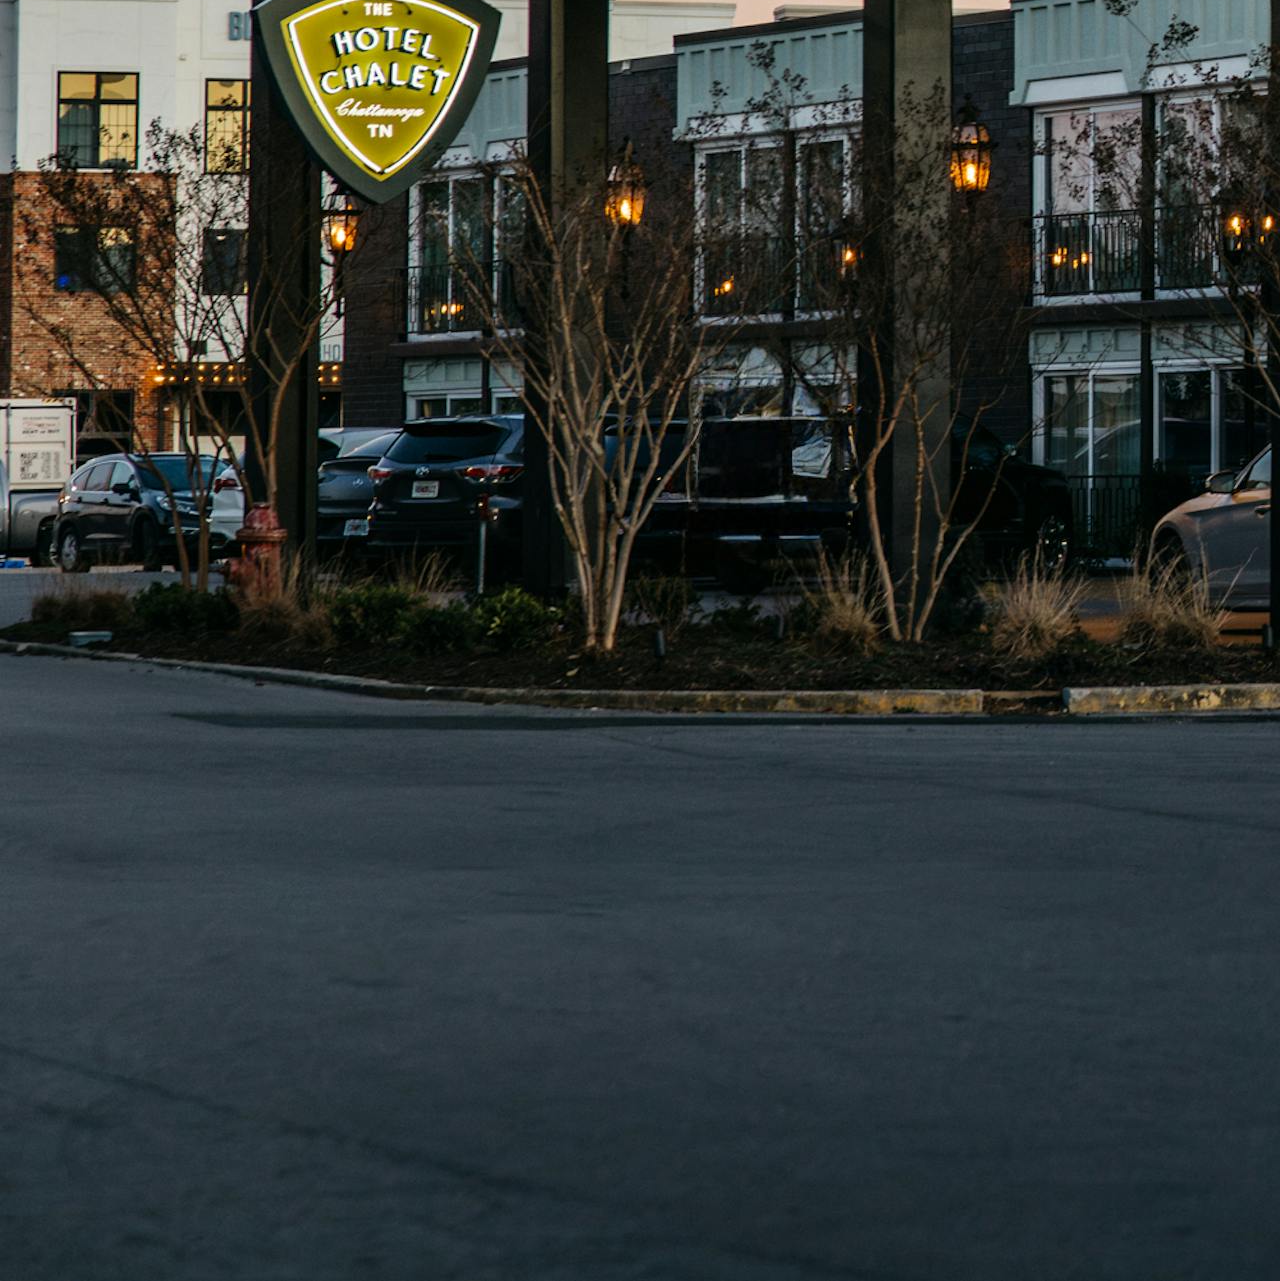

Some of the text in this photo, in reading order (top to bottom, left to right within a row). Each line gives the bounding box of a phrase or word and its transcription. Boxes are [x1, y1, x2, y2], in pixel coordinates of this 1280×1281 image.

[363, 2, 393, 16] THE
[333, 26, 439, 60] HOTEL
[320, 62, 450, 95] CHALET
[335, 98, 425, 123] Chattanooga
[367, 124, 393, 138] TN
